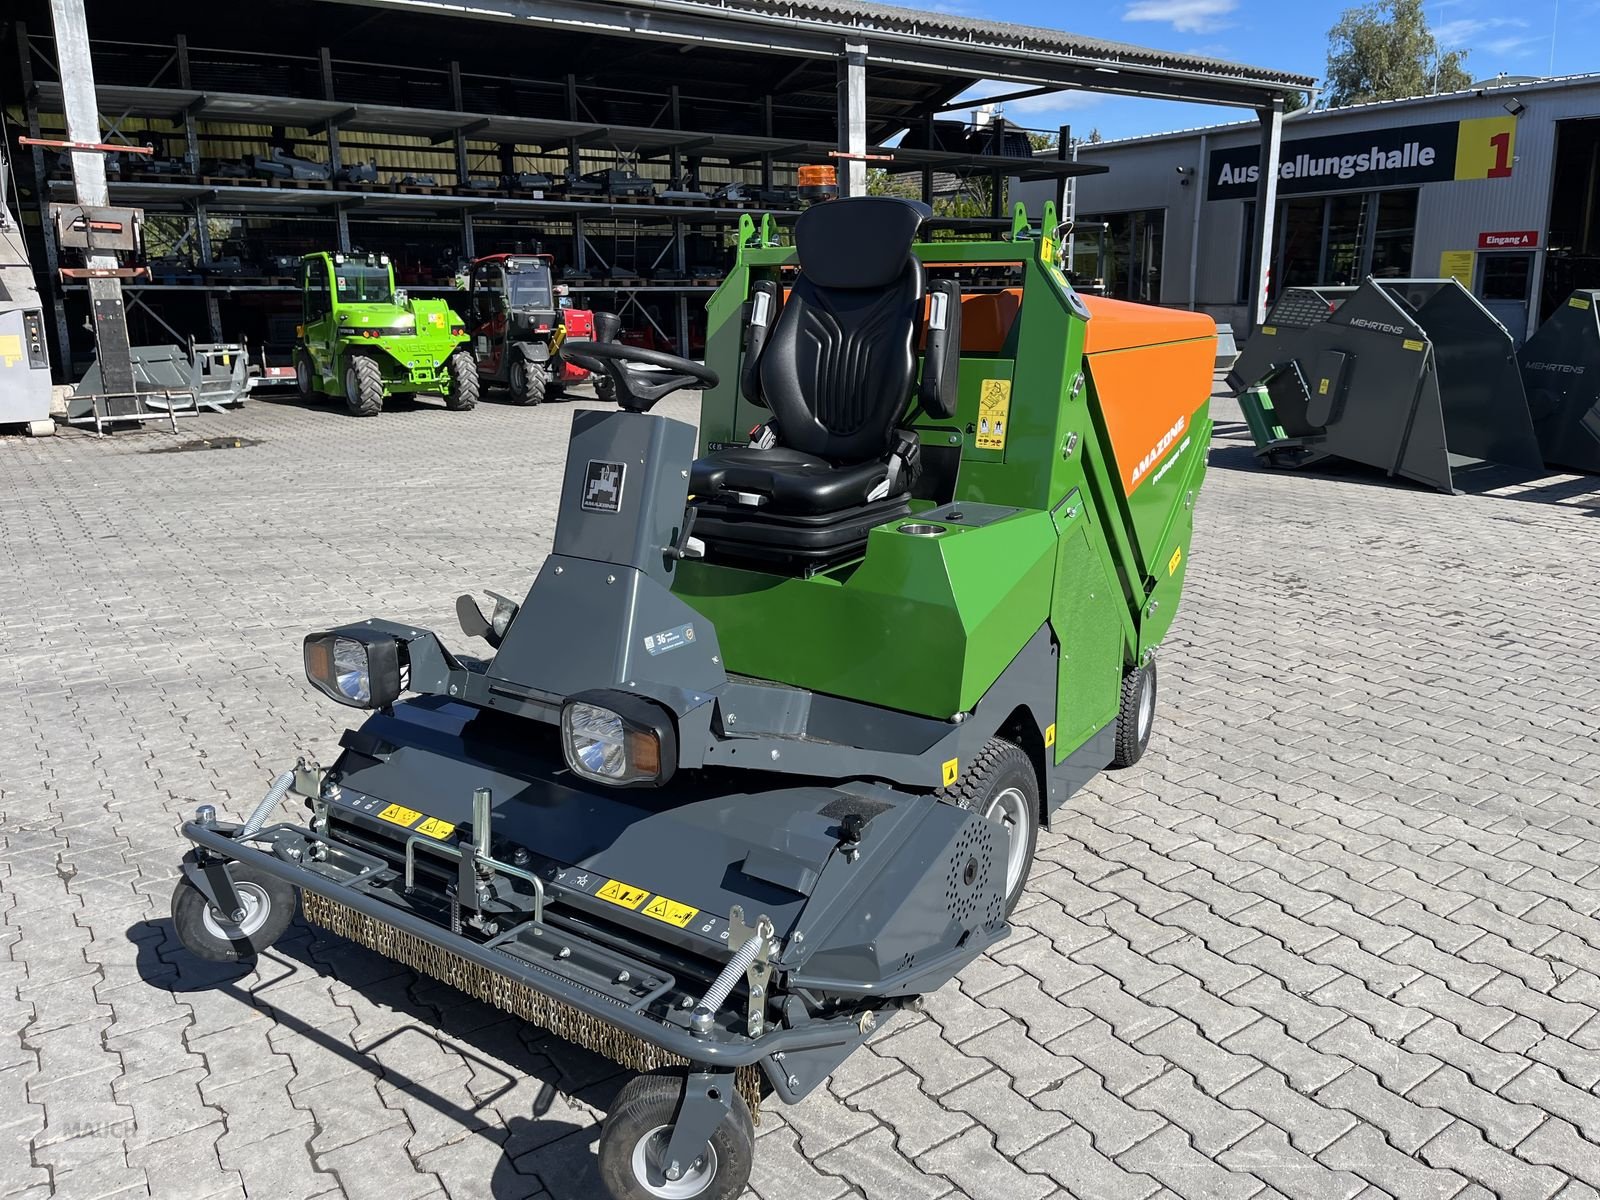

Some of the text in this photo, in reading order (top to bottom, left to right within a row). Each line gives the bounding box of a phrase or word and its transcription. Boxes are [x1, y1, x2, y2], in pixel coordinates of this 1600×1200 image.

[1217, 132, 1512, 185] Ausellungshalle 1
[1486, 234, 1529, 245] Eingang A
[1349, 317, 1405, 335] MEHRTENS
[1525, 361, 1585, 374] MEHRTENS
[1131, 415, 1185, 485] AMAZONE
[656, 633, 666, 645] 36
